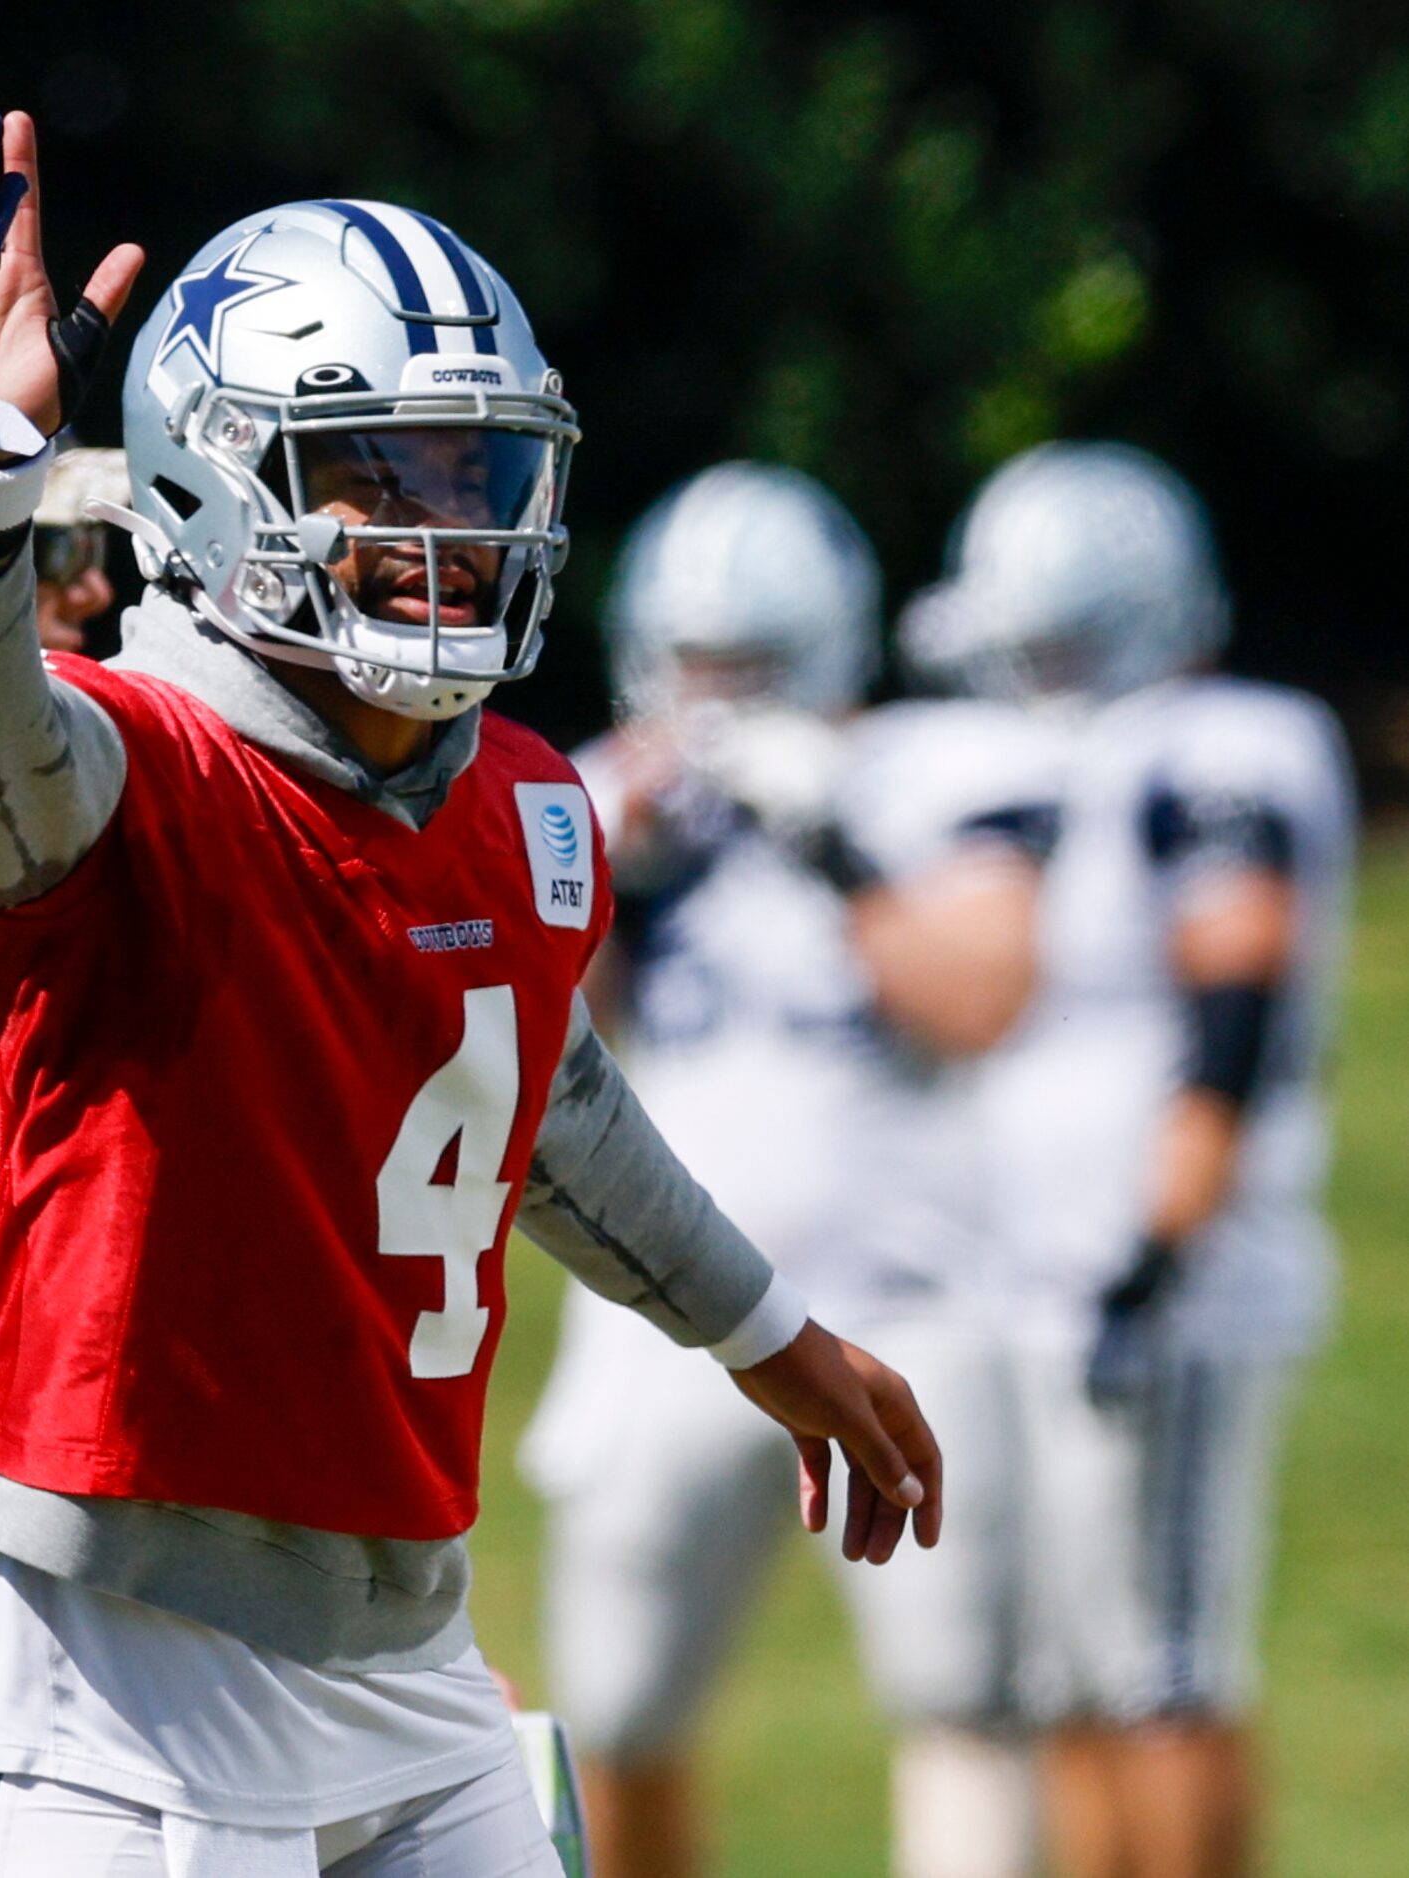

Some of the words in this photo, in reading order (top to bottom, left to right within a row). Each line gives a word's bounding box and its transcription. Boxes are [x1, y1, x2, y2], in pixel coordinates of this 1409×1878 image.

[432, 368, 502, 386] COWBOYS
[551, 879, 584, 907] AT&T
[376, 983, 520, 1379] 4
